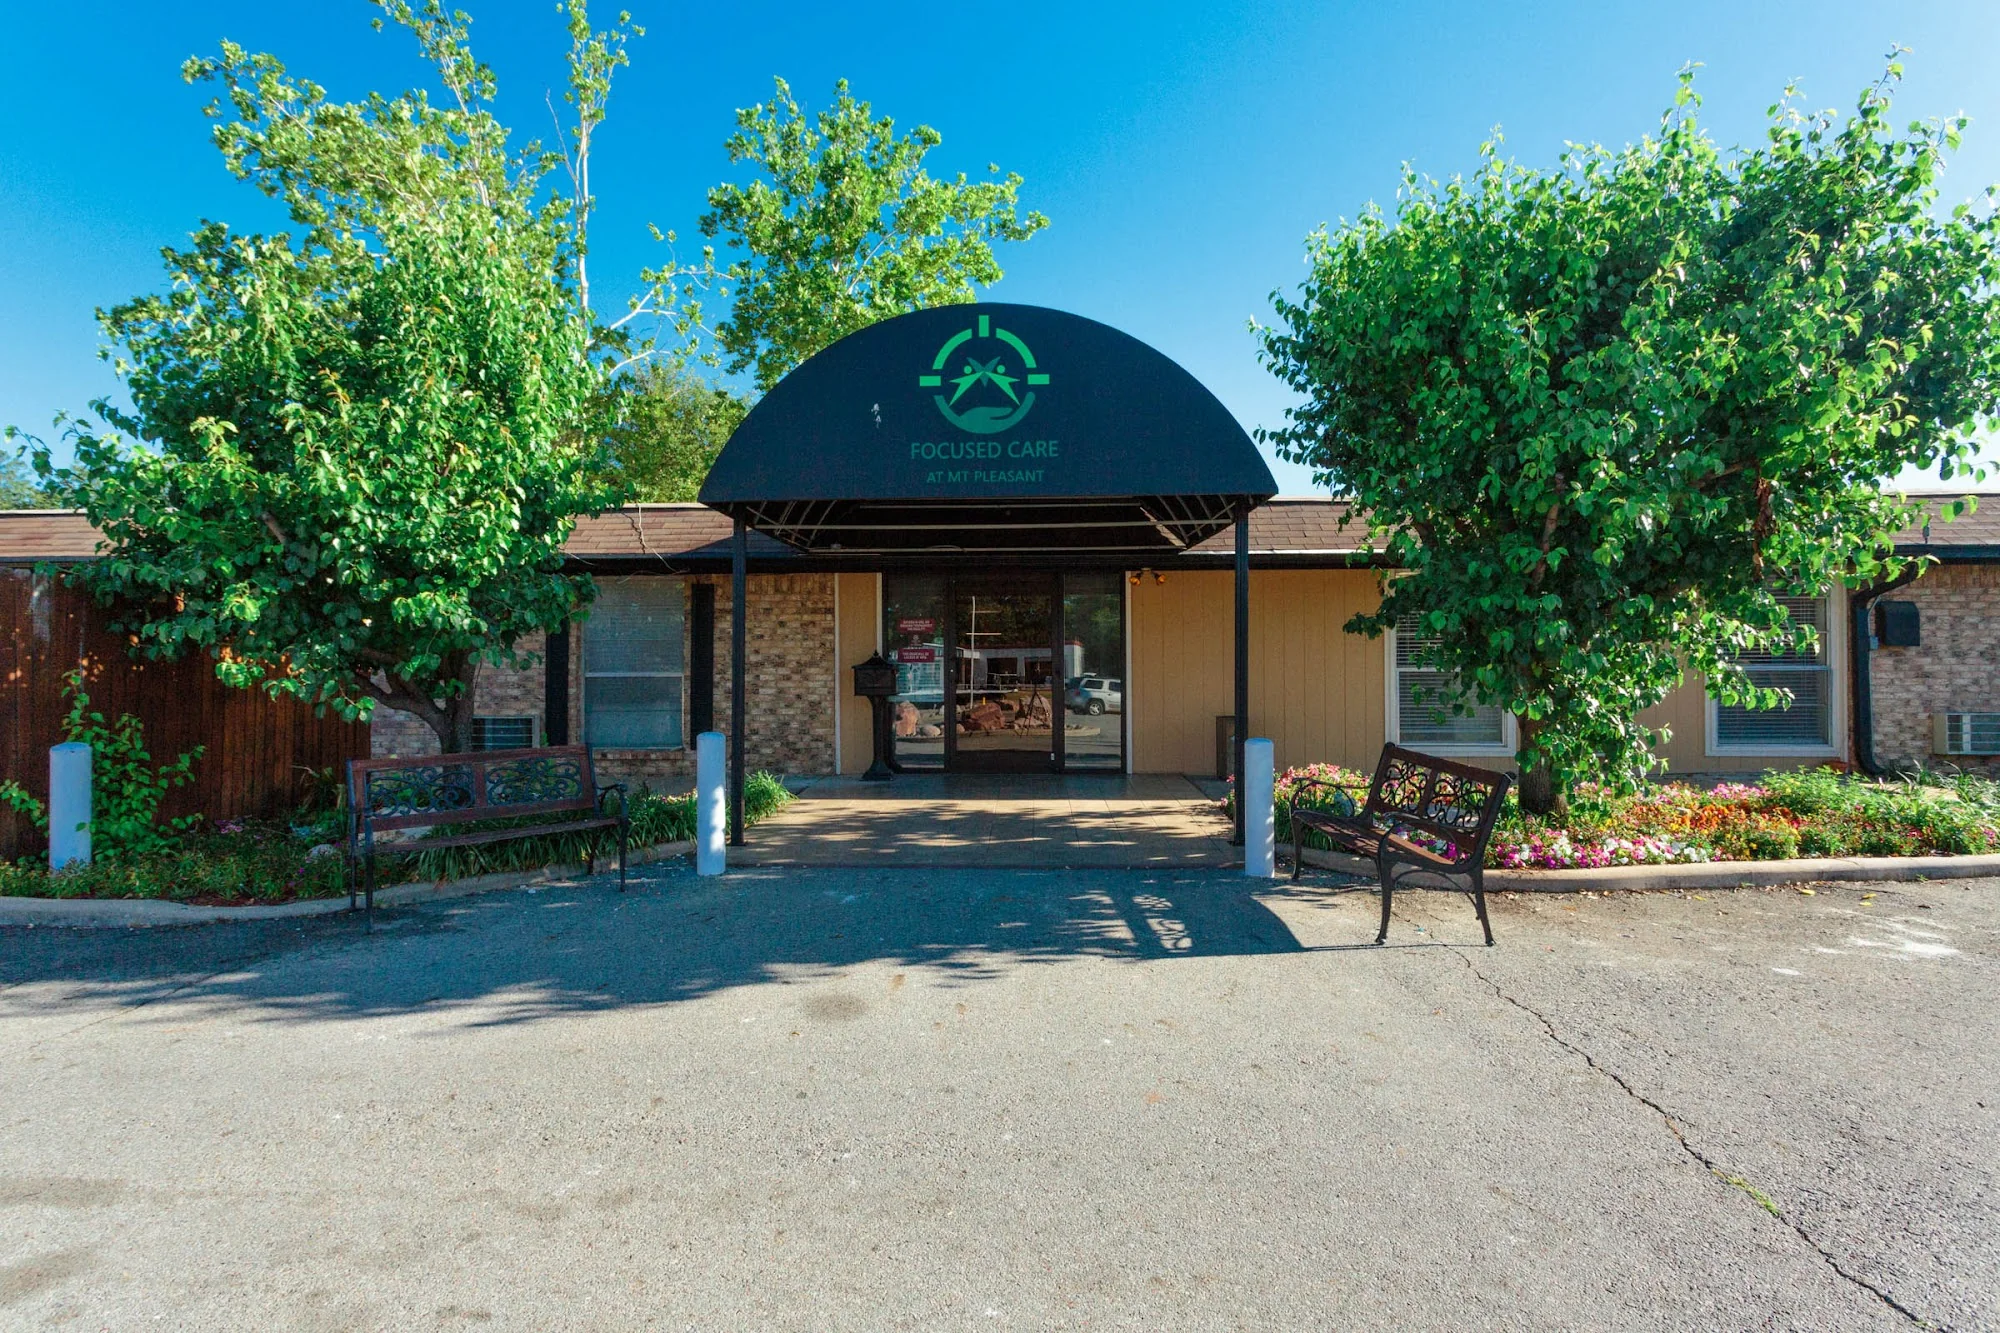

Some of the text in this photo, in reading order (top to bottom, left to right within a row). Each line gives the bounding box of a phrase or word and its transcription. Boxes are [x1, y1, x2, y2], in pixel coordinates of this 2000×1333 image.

[911, 440, 1058, 459] FOCUSED CARE
[926, 470, 1044, 483] AT MT PLEASANT
